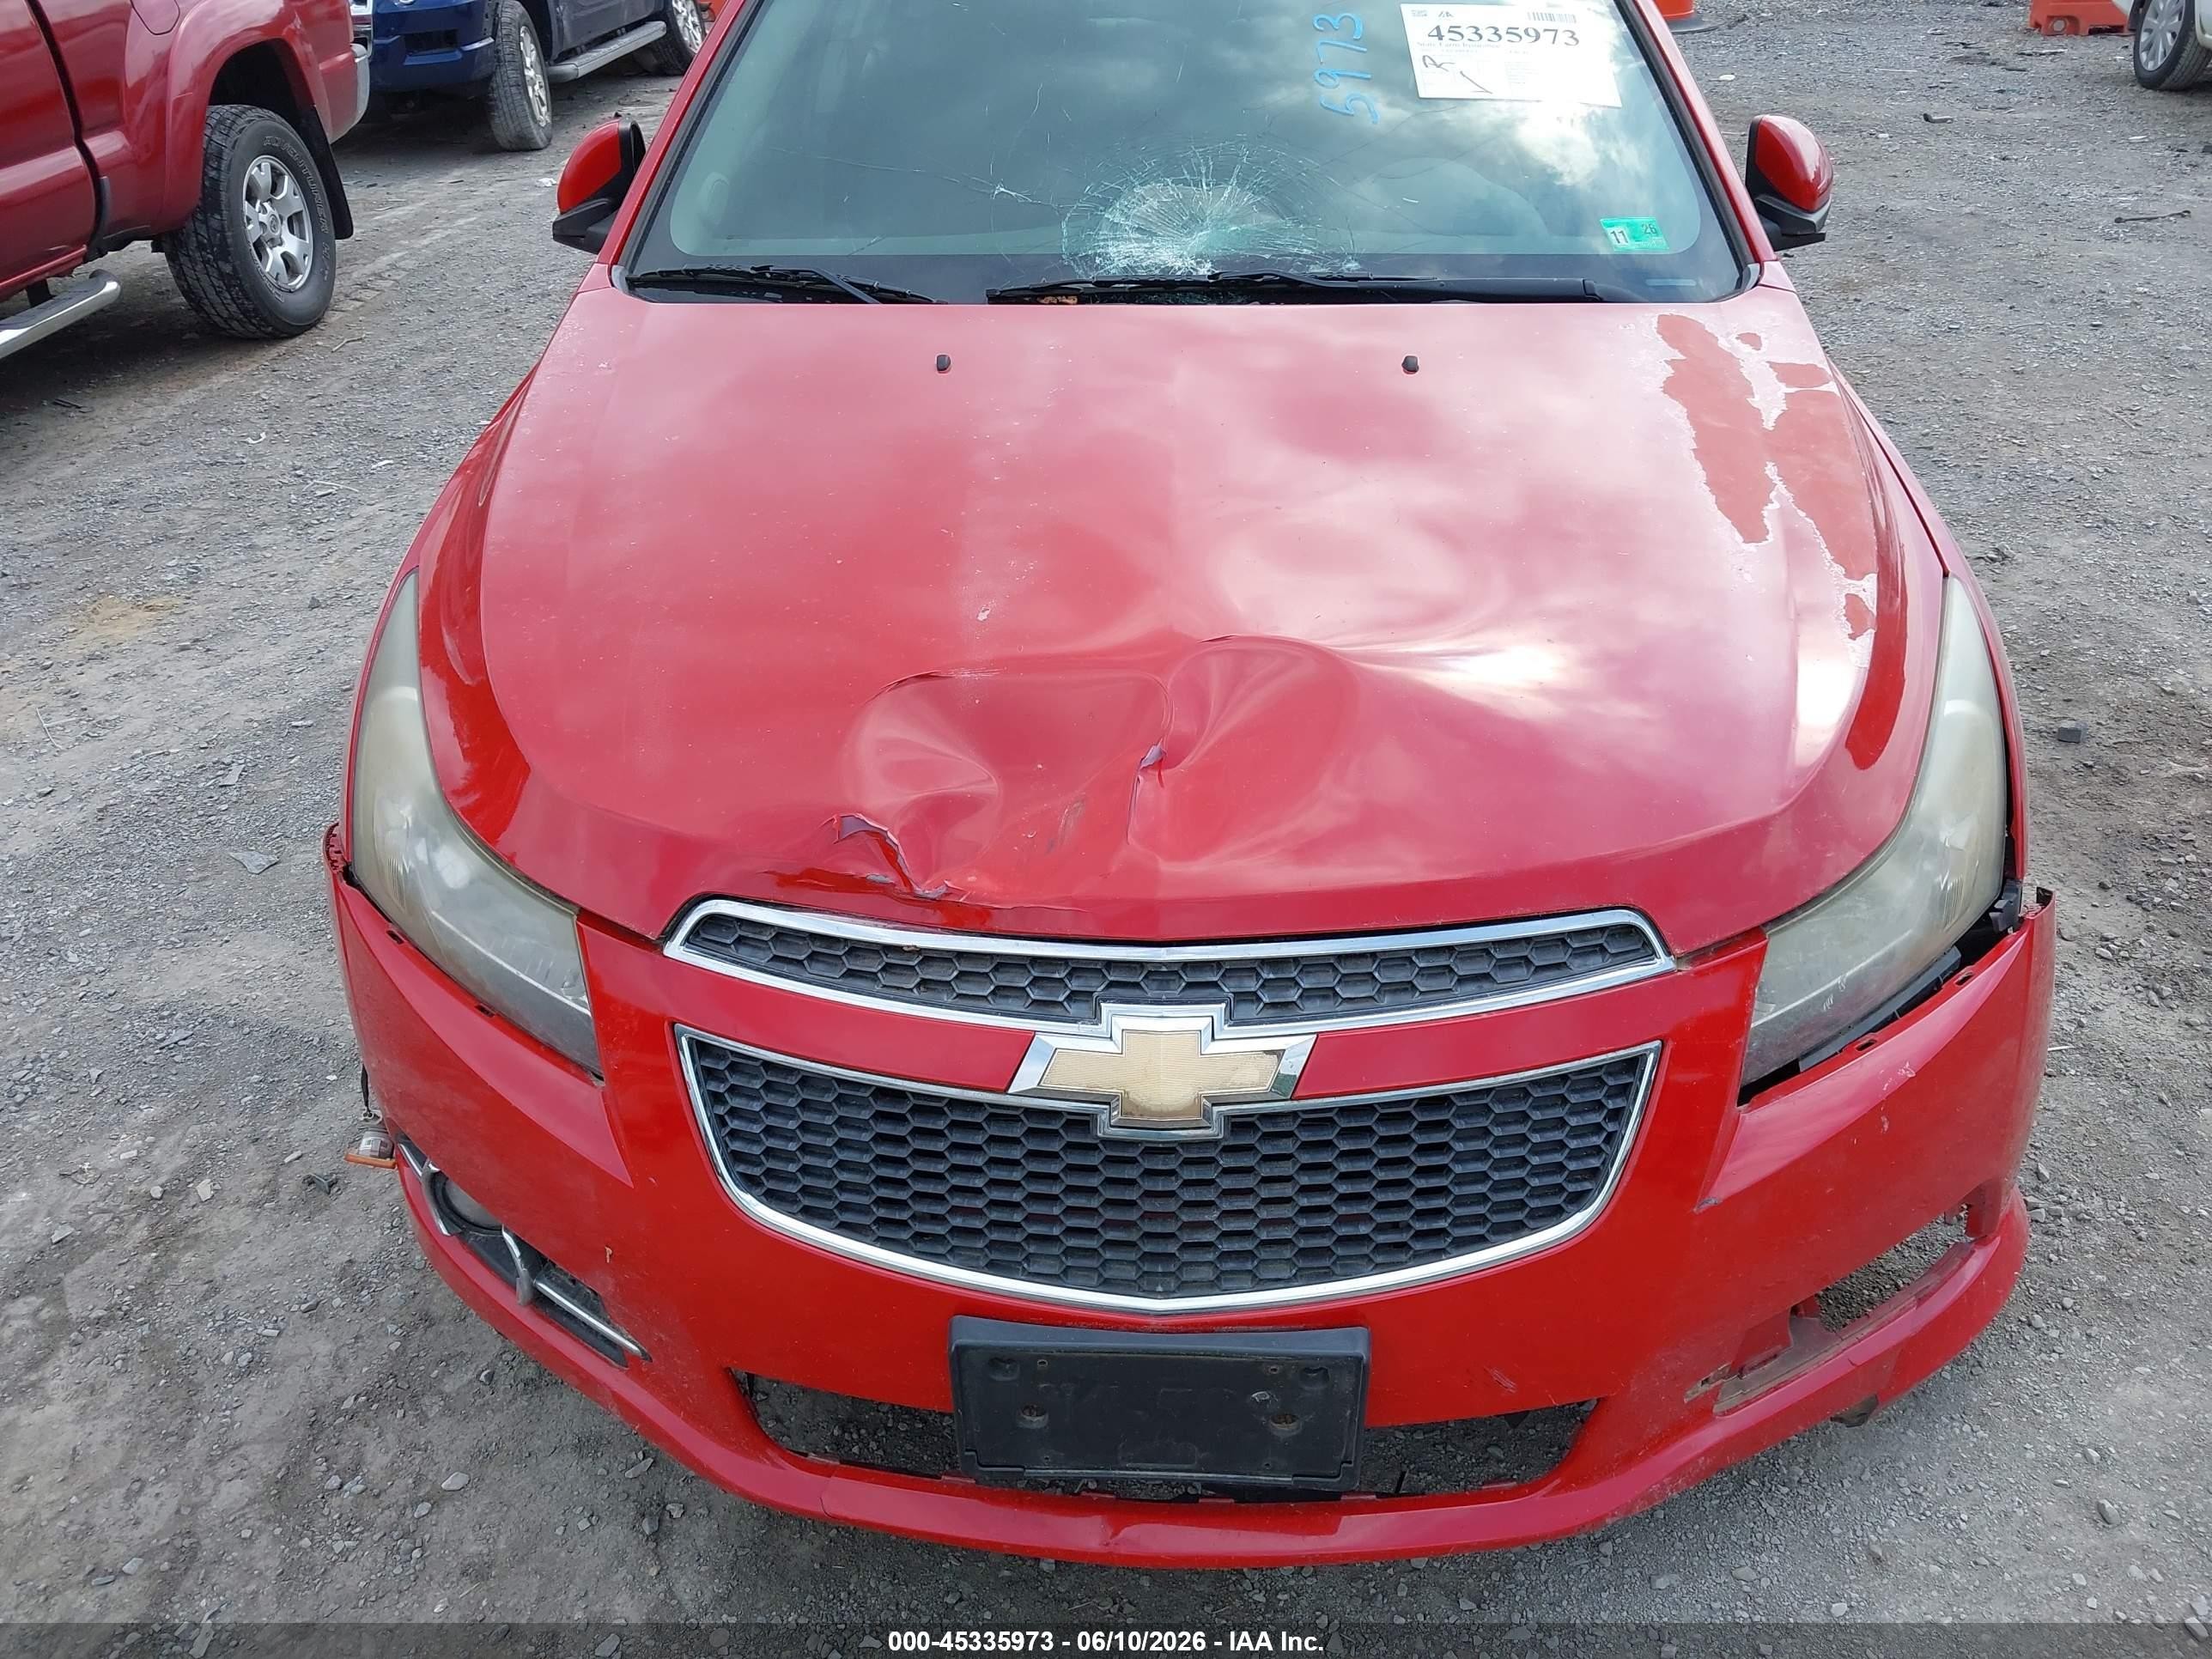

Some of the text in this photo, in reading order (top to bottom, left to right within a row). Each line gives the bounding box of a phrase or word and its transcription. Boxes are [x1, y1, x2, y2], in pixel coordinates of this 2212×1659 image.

[1427, 24, 1580, 46] 45335973
[1313, 13, 1380, 124] 5973
[1610, 230, 1629, 244] 11
